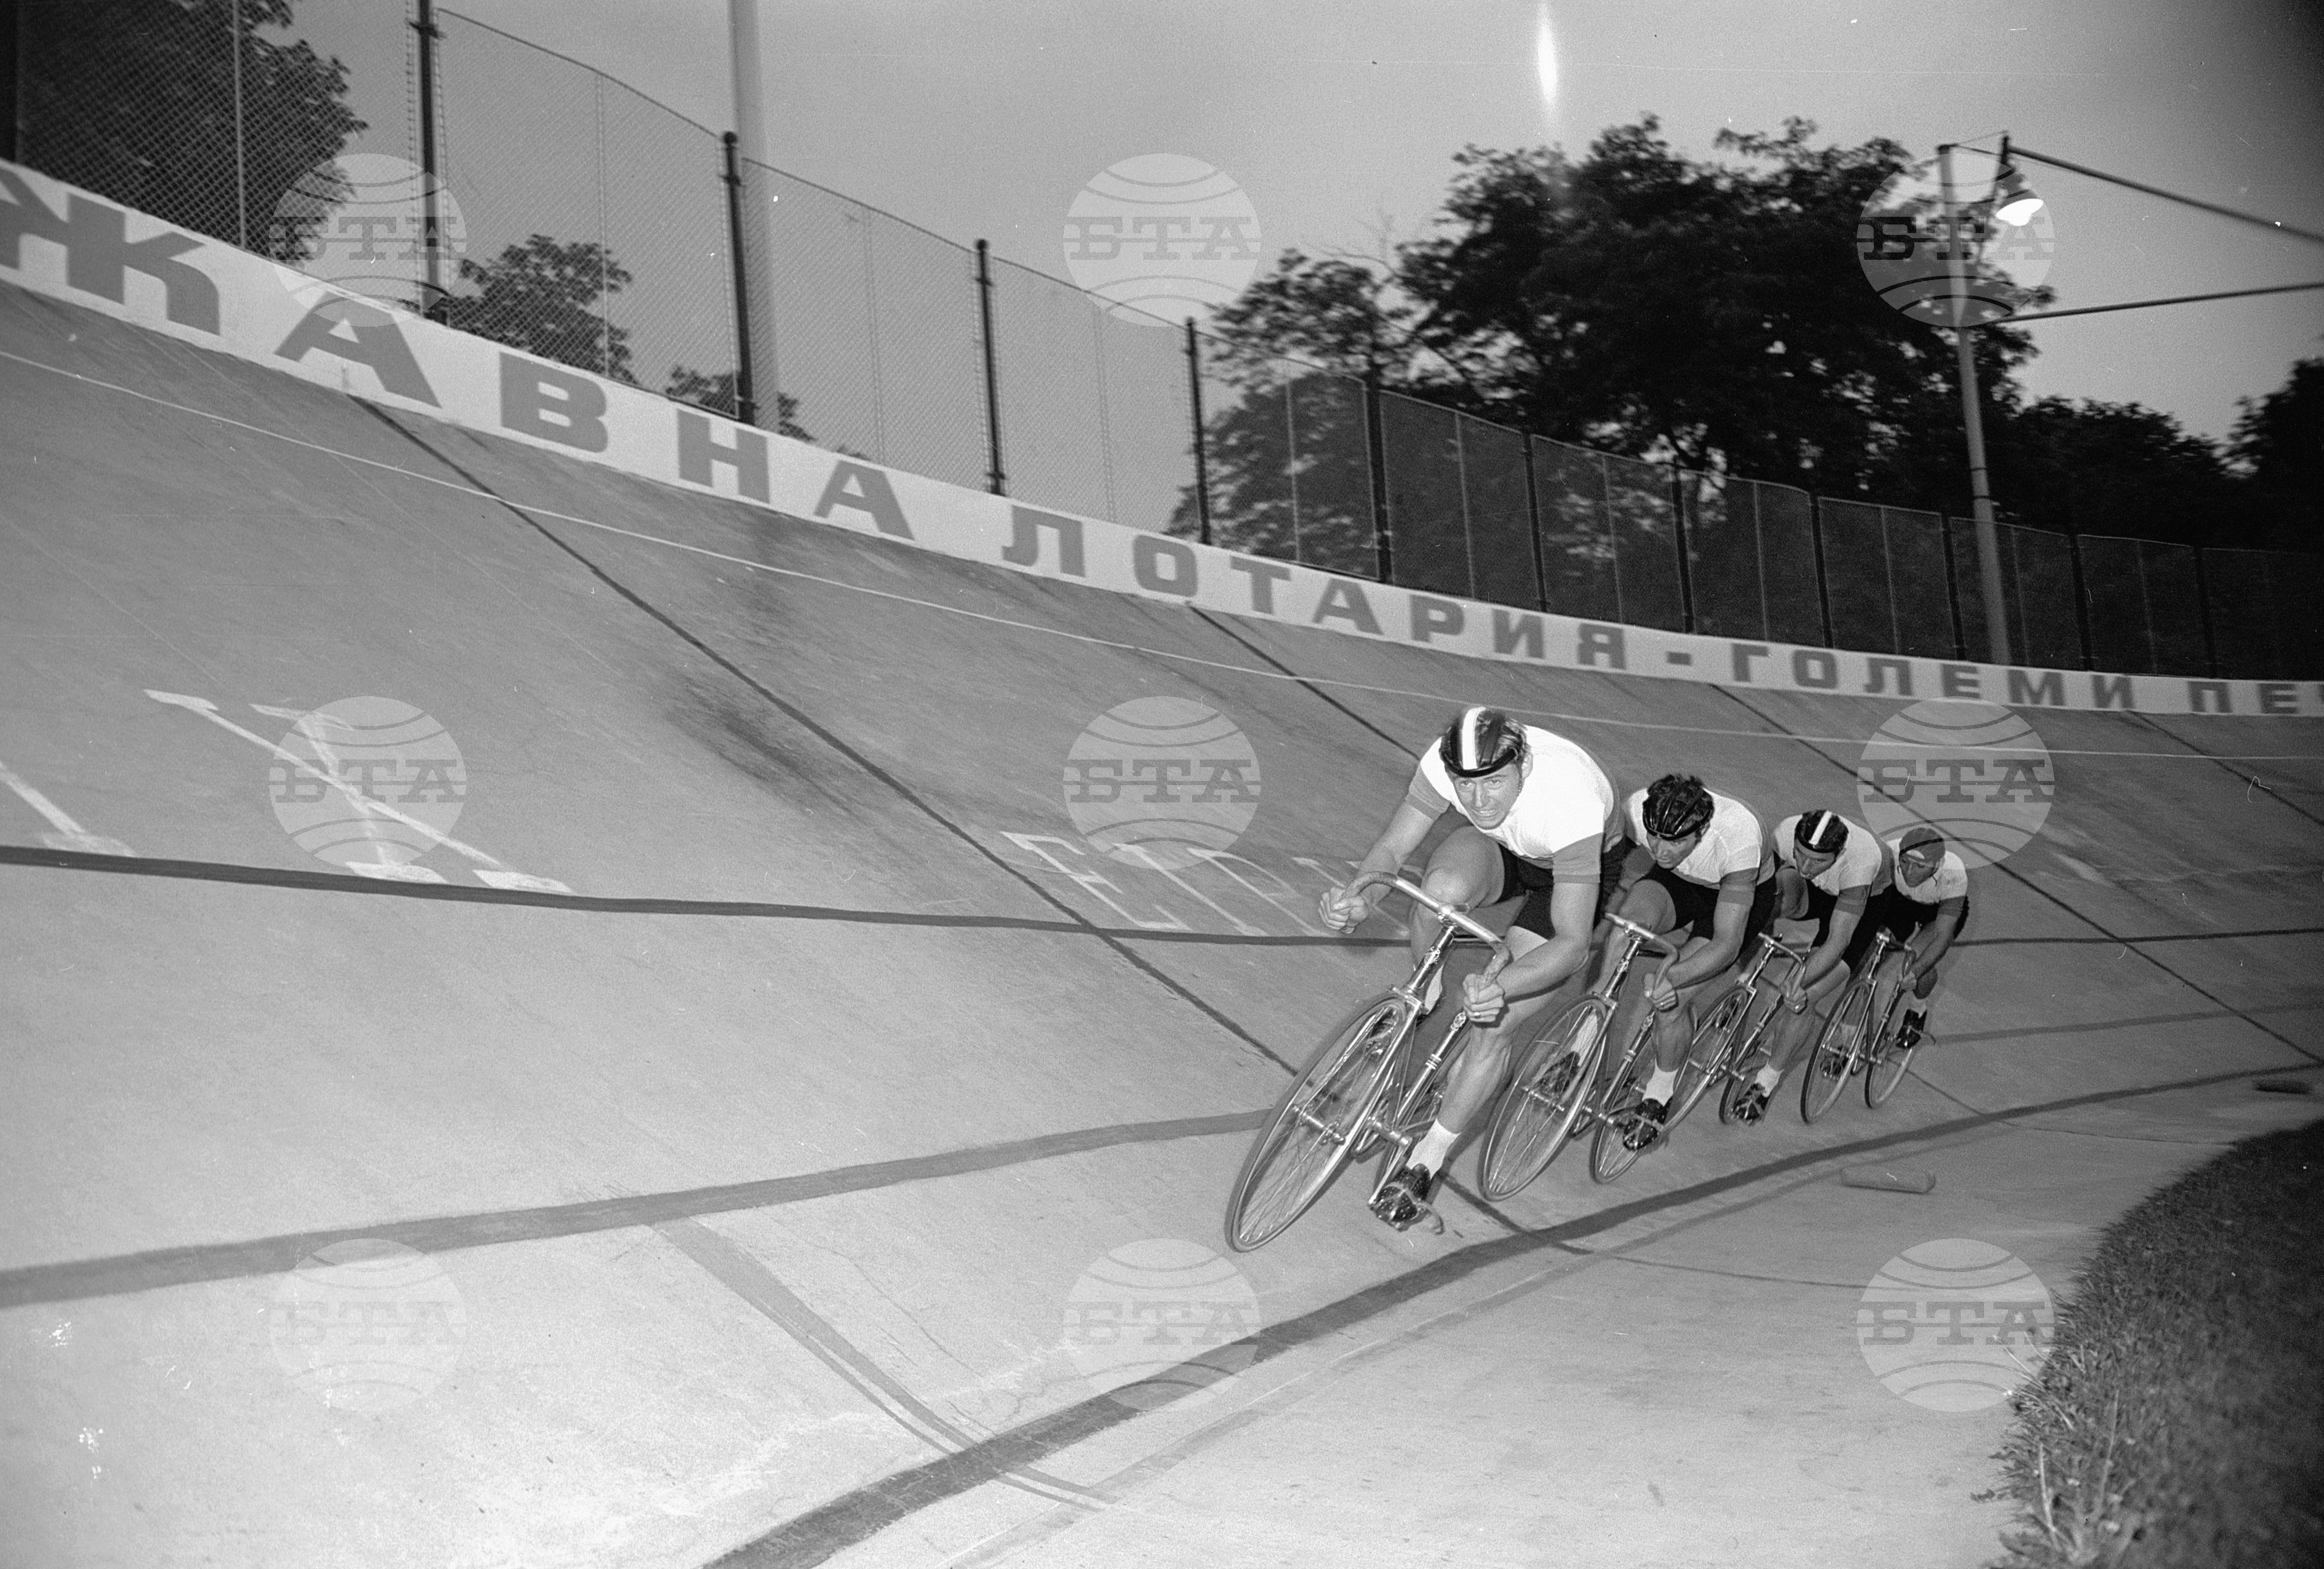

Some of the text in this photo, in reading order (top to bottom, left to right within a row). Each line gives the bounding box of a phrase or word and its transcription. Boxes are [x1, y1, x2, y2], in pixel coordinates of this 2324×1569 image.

[1002, 503, 1627, 670] ЛОТАРИЯ
[1731, 643, 2136, 711] ГОЛЕМИ
[2187, 680, 2324, 714] ПЕ
